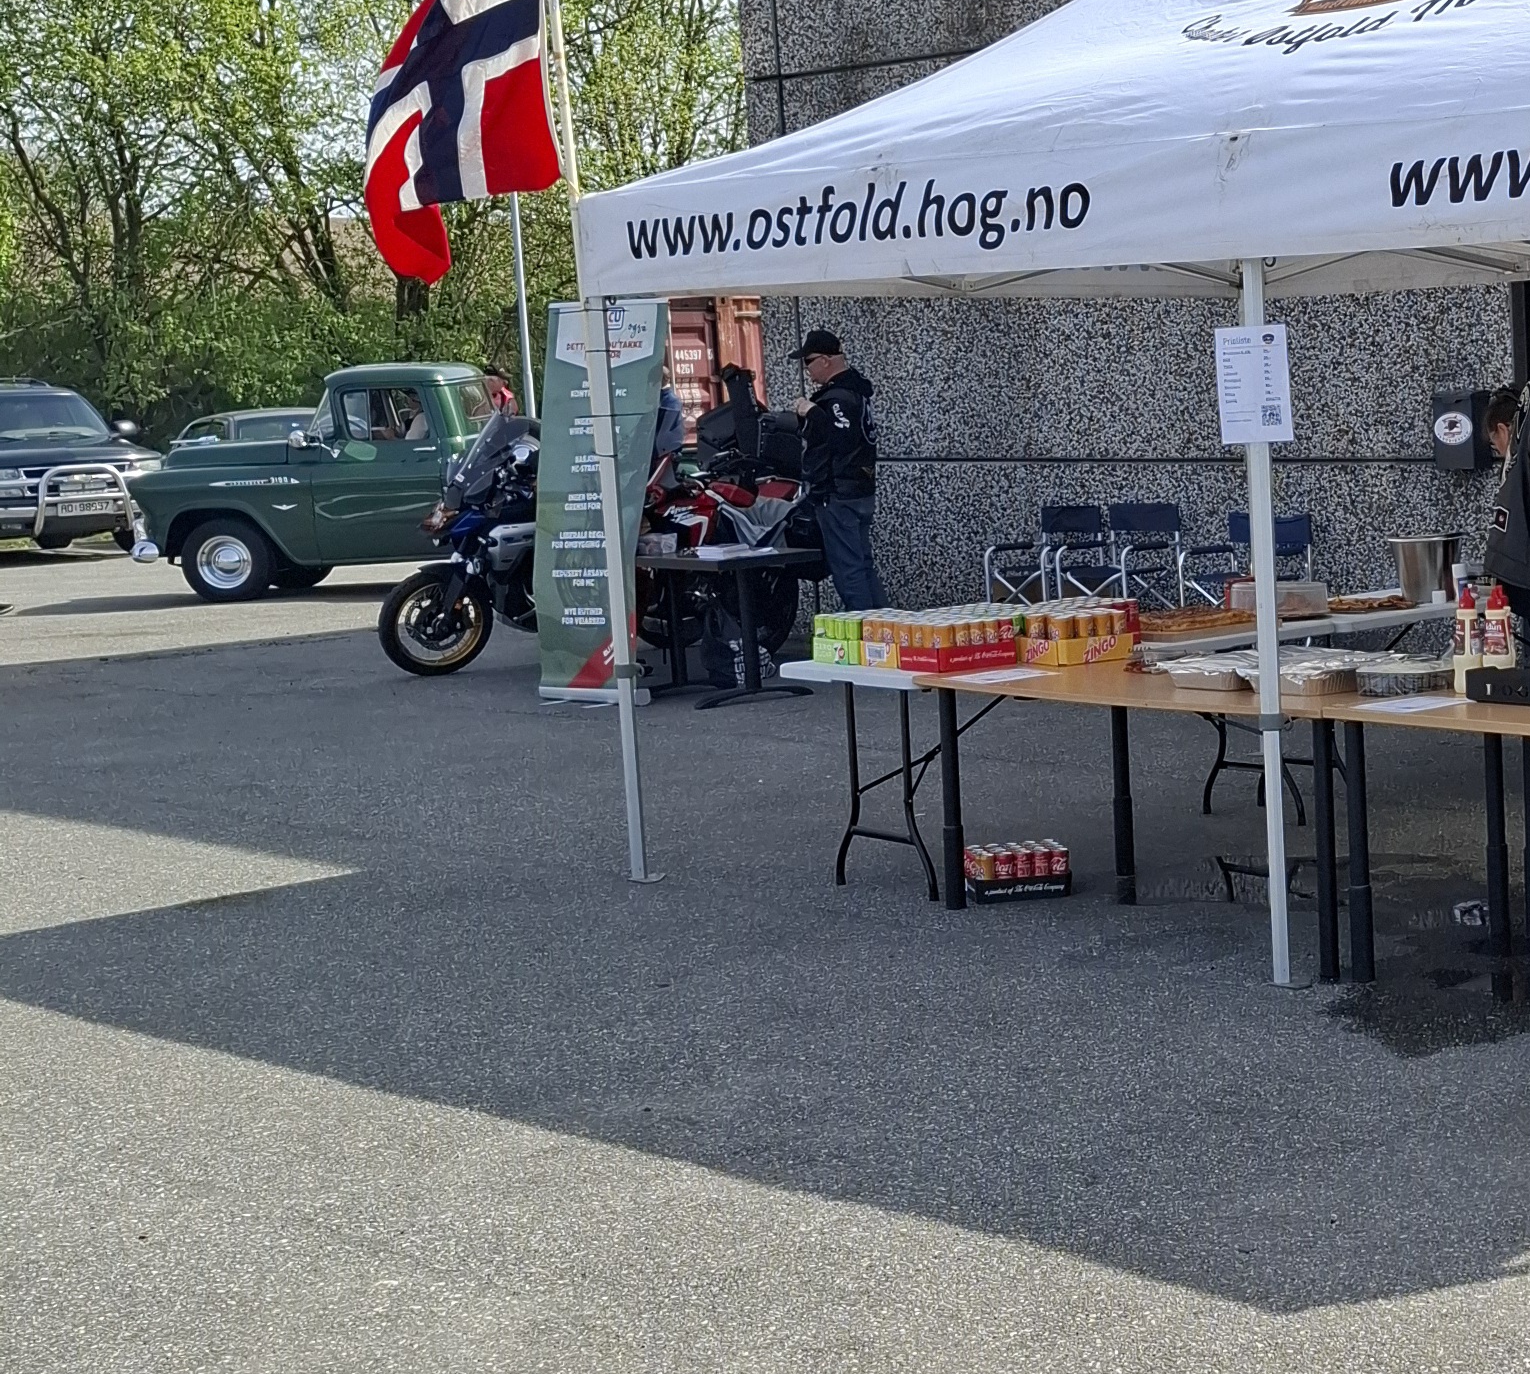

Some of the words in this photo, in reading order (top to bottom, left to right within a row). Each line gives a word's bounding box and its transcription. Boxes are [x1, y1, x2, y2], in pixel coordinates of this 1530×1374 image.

[626, 178, 1092, 259] www.ostfold.hog.no
[566, 342, 586, 351] DETT
[571, 465, 601, 473] MC-STRAT
[1024, 639, 1050, 663] ZINGO
[1083, 635, 1118, 663] ZINGO
